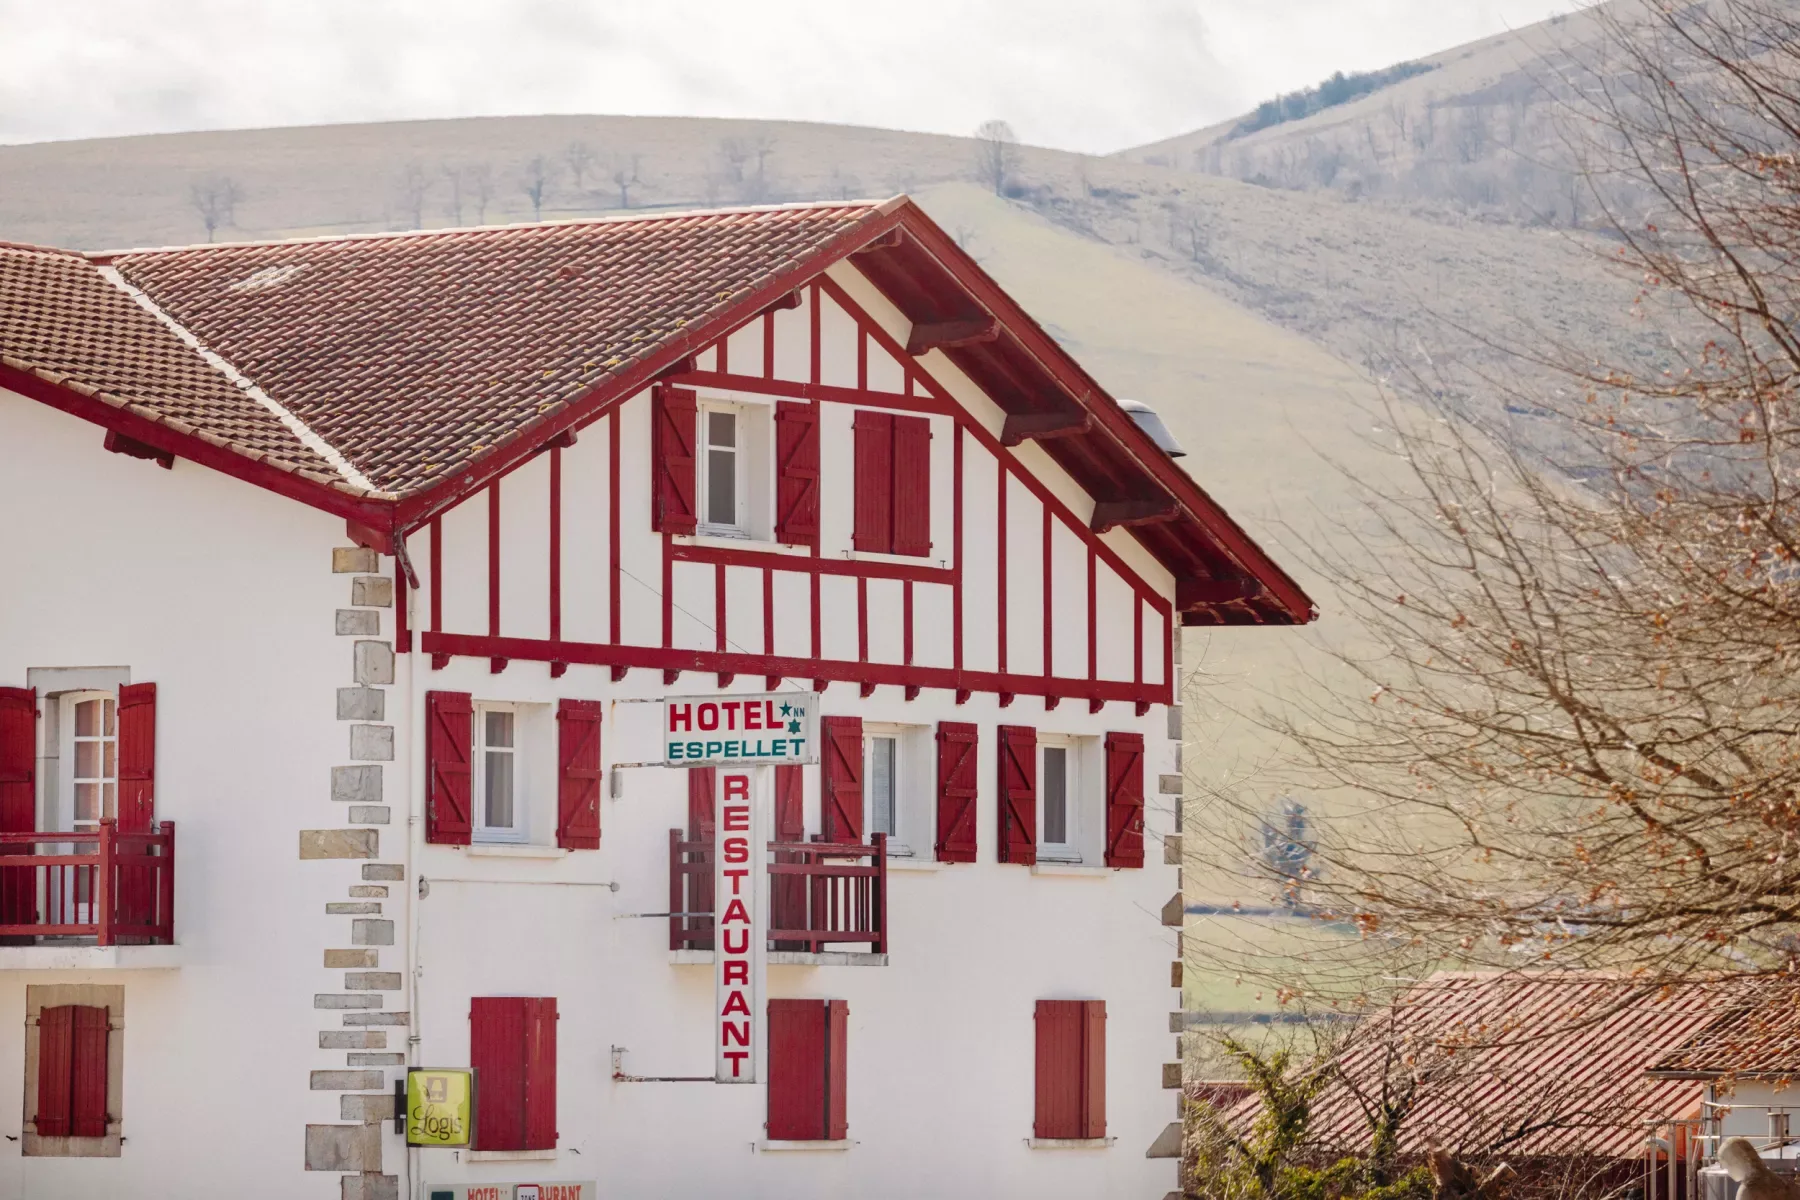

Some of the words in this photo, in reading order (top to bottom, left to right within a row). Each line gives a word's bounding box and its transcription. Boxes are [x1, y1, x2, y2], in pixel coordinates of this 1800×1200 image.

[669, 700, 784, 732] HOTEL
[793, 707, 805, 718] NN
[668, 738, 806, 759] ESPELLET
[721, 775, 751, 1077] RESTAURANT
[410, 1104, 463, 1141] Logis
[539, 1184, 582, 1200] AURANT
